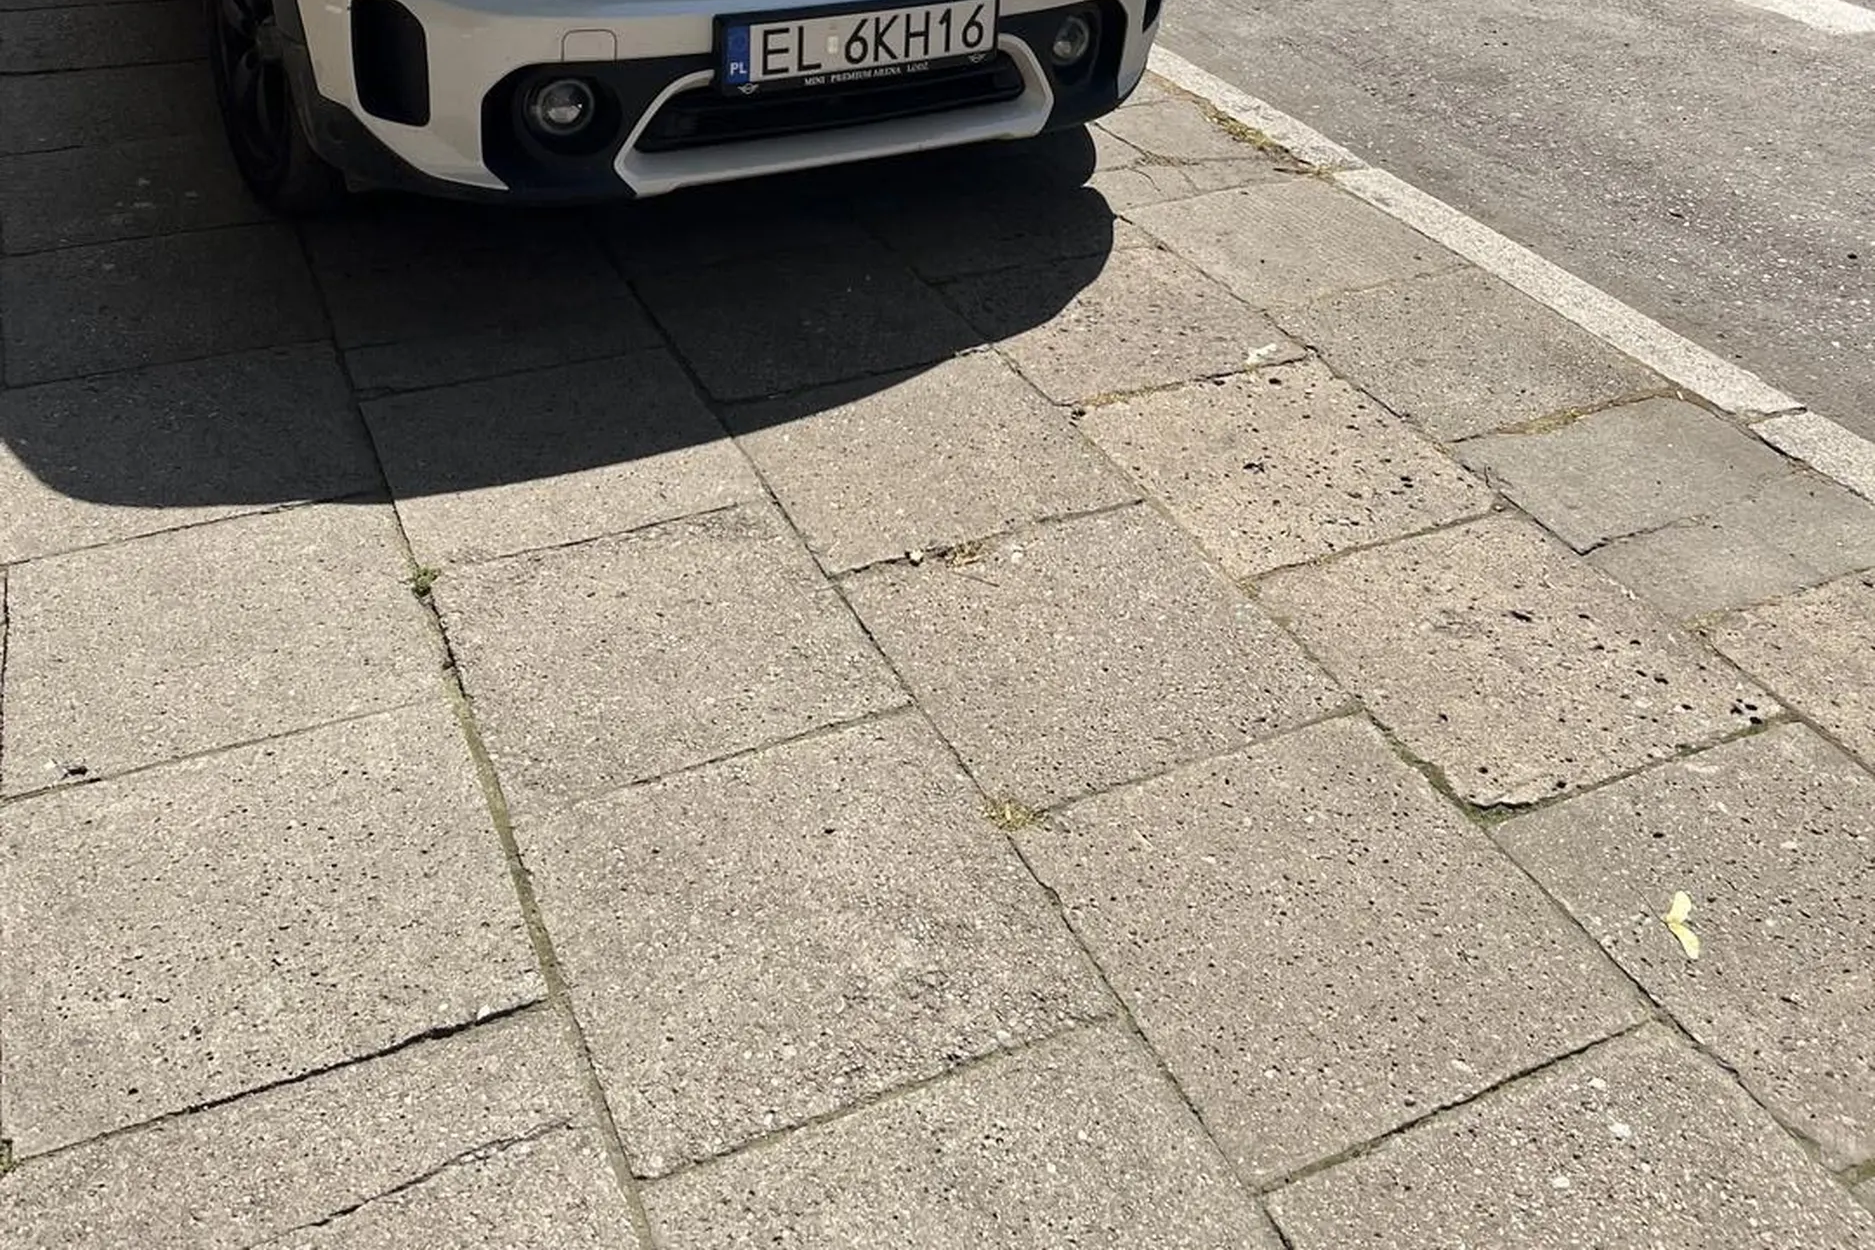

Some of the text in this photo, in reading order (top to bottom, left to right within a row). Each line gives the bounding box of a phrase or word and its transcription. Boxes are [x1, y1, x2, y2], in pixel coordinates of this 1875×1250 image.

[762, 3, 984, 76] EL 6KH16
[730, 61, 748, 75] PL
[804, 75, 826, 86] MINI
